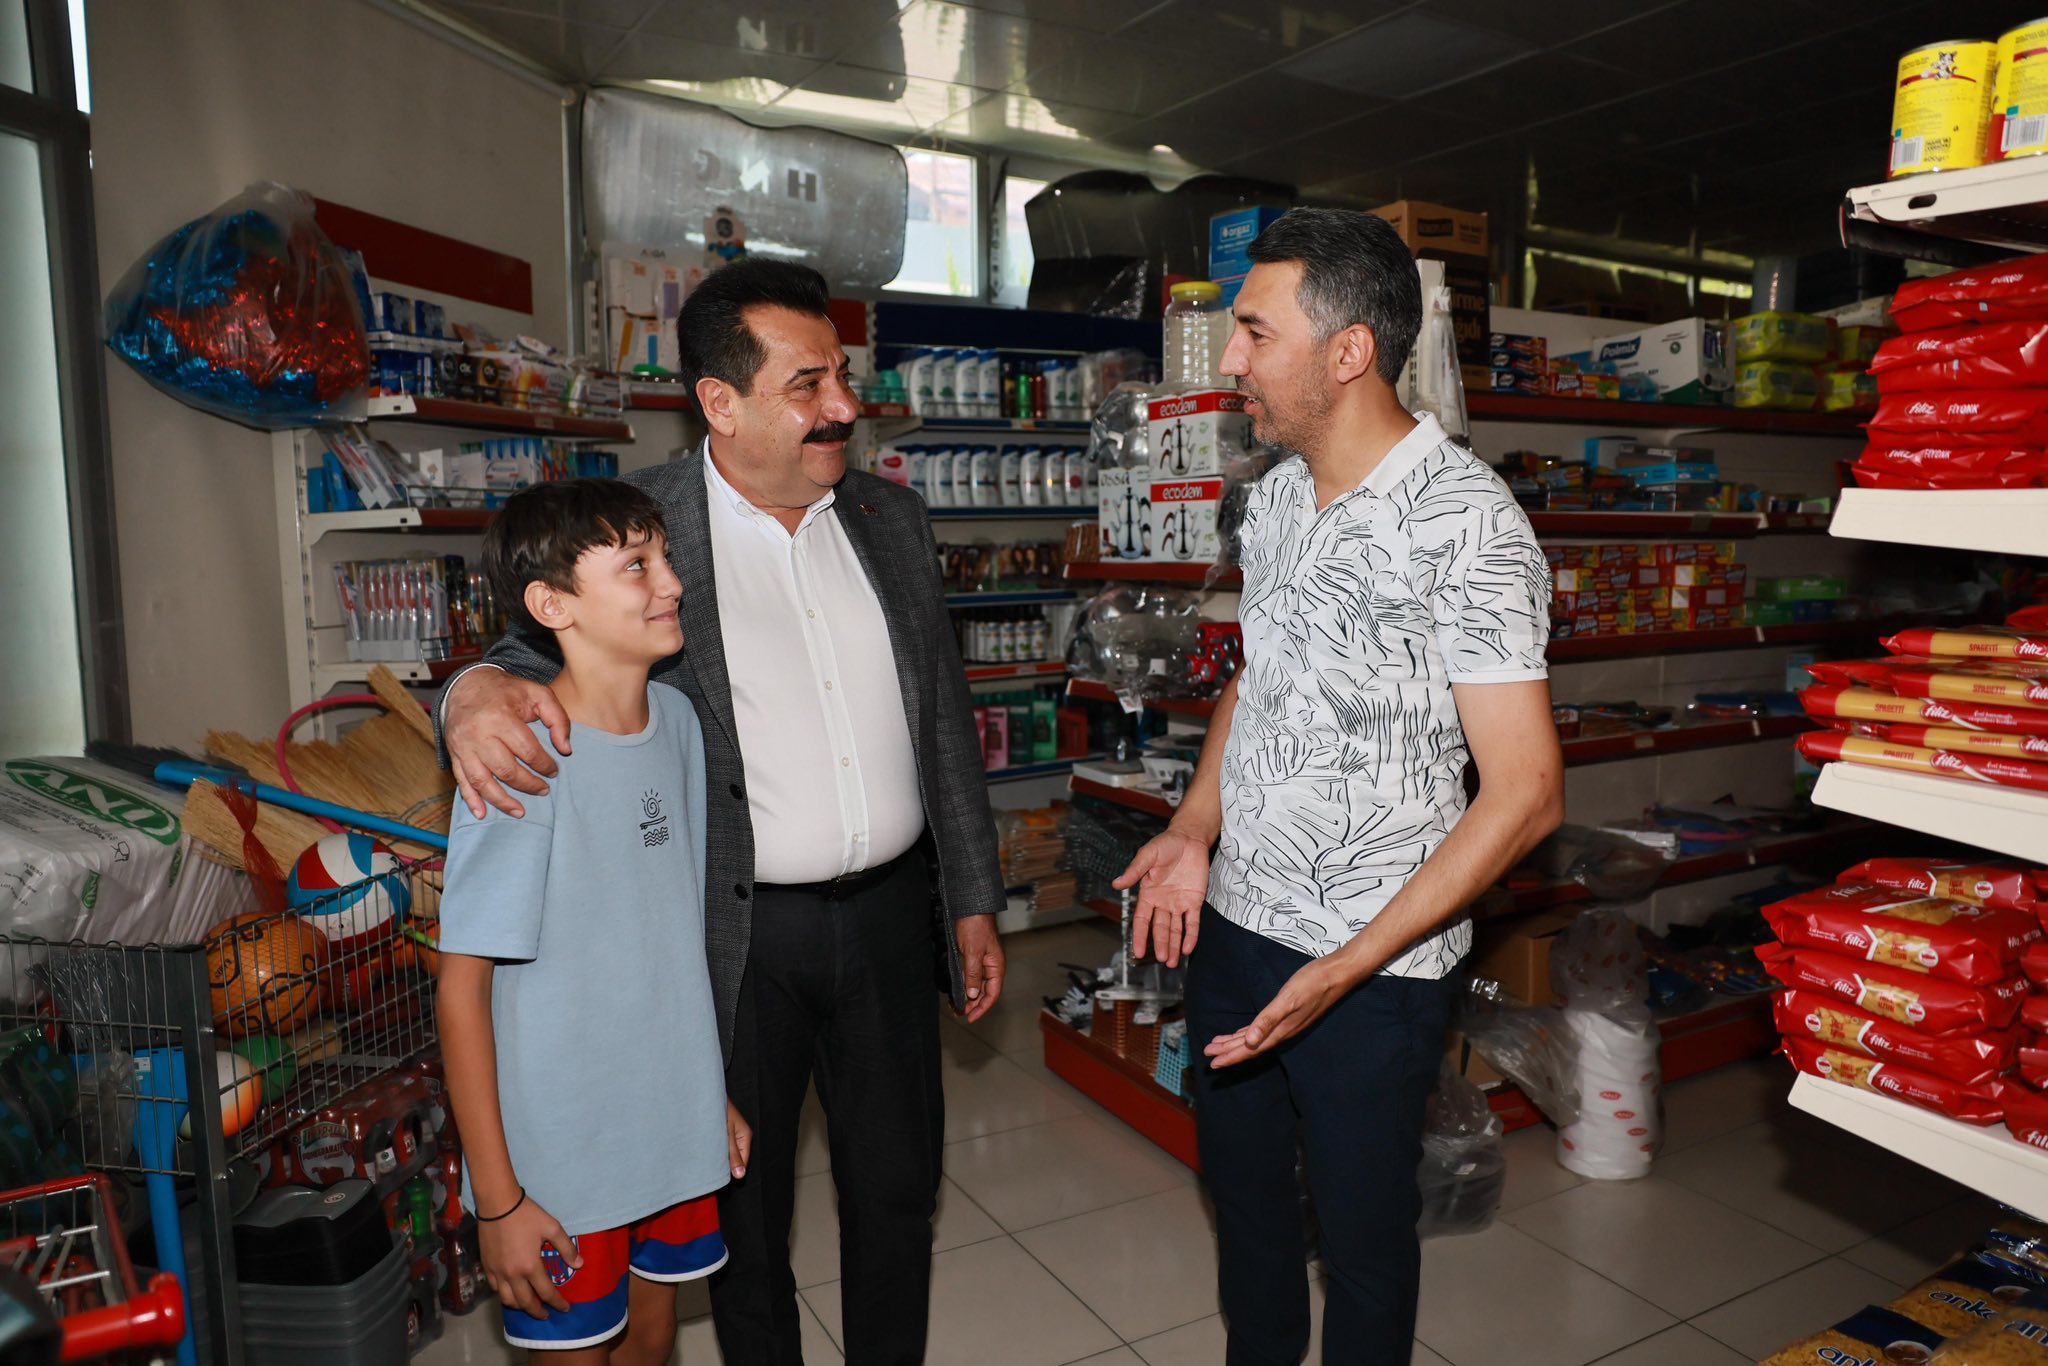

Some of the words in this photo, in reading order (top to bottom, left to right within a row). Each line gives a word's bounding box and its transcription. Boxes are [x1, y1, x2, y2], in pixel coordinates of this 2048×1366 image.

[1159, 399, 1198, 417] ecodem
[1162, 484, 1203, 501] ecodem
[2019, 642, 2047, 656] filiz
[1925, 704, 1953, 719] filiz
[1936, 753, 1966, 770] filiz
[1907, 877, 1928, 890] filiz
[1843, 932, 1870, 948] filiz
[1833, 980, 1857, 996] filiz
[1869, 1033, 1893, 1051] filiz
[1879, 1076, 1903, 1093] filiz
